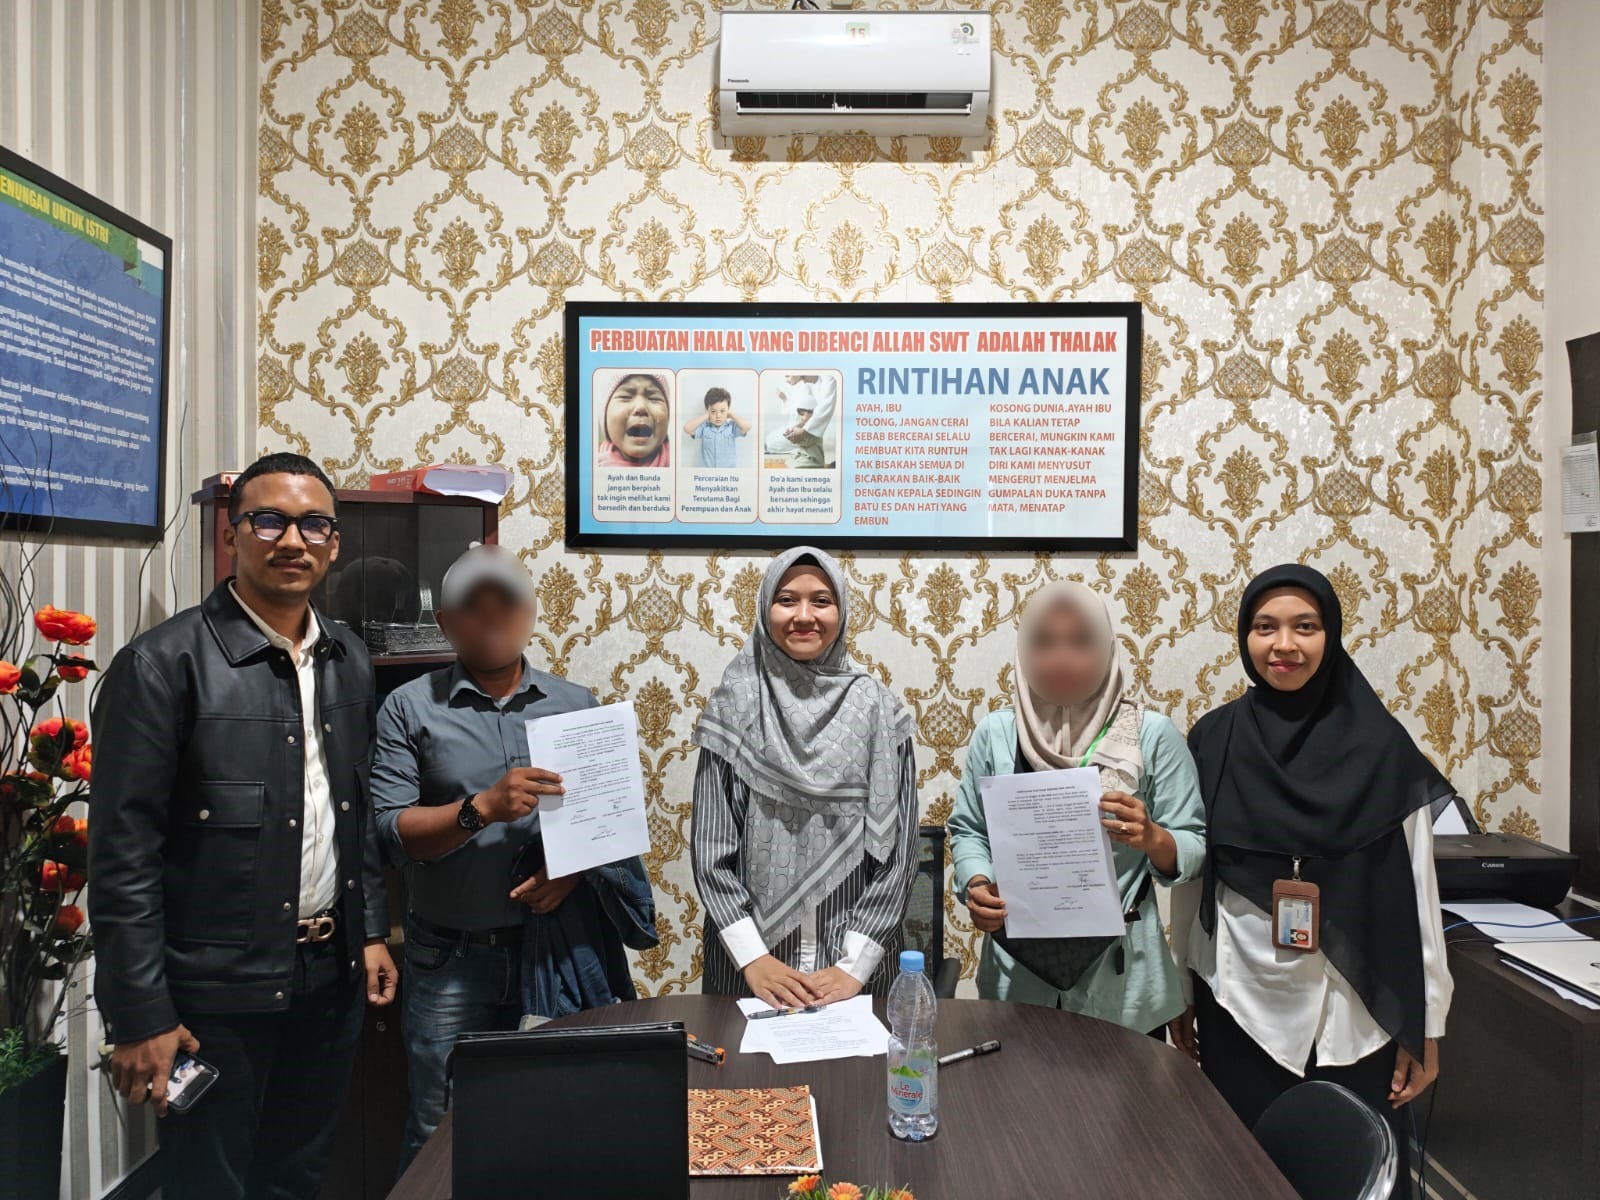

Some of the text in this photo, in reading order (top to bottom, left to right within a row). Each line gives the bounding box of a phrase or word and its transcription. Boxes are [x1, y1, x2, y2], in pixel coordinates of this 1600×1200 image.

[850, 27, 866, 38] 15
[0, 175, 109, 244] ENUNGAN UNTUK ISTRI
[590, 330, 1117, 352] PERBUATAN HALAL YANG DIBENCI ALLAH SWT ADALAH THALAK
[858, 367, 1110, 395] RINTIHAN ANAK
[856, 404, 902, 414] AYAH, IBU
[990, 404, 1031, 413] KOSONG
[1095, 404, 1112, 413] IBU
[856, 418, 969, 428] TOLONG, JANGAN CERAI
[990, 418, 1081, 427] BILA KALIAN TETAP
[855, 432, 971, 441] SEBAB BERCERAI SELALU
[989, 432, 1115, 442] BERCERAI, MUNGKIN KAMI
[855, 446, 968, 455] MEMBUAT KITA RUNTUH
[988, 446, 1105, 456] TAK LAGI KANAK-KANAK
[855, 460, 965, 469] TAK BISAKAH SEMUA DI
[989, 461, 1092, 470] DIRI KAMI MENYUSUT
[608, 474, 624, 482] Ayah
[770, 475, 831, 484] Do'a kami semoga
[855, 474, 961, 484] BICARAKAN BAIK-BAIK
[988, 475, 1097, 484] MENGERUT MENJELMA
[607, 484, 661, 492] jangan berpisah
[695, 485, 738, 493] Menyakitkan
[769, 486, 786, 494] Ayah
[854, 489, 981, 498] DENGAN KEPALA SEDINGIN
[988, 489, 1106, 498] GUMPALAN DUKA TANPA
[725, 495, 741, 503] Bagi
[800, 496, 831, 504] sehingga
[681, 505, 720, 513] Perempuan
[785, 506, 805, 514] hayat
[854, 503, 967, 512] BATU ES DAN HATI YANG
[988, 503, 1066, 513] MATA, MENATAP
[854, 517, 889, 525] EMBUN
[900, 1080, 910, 1091] Le
